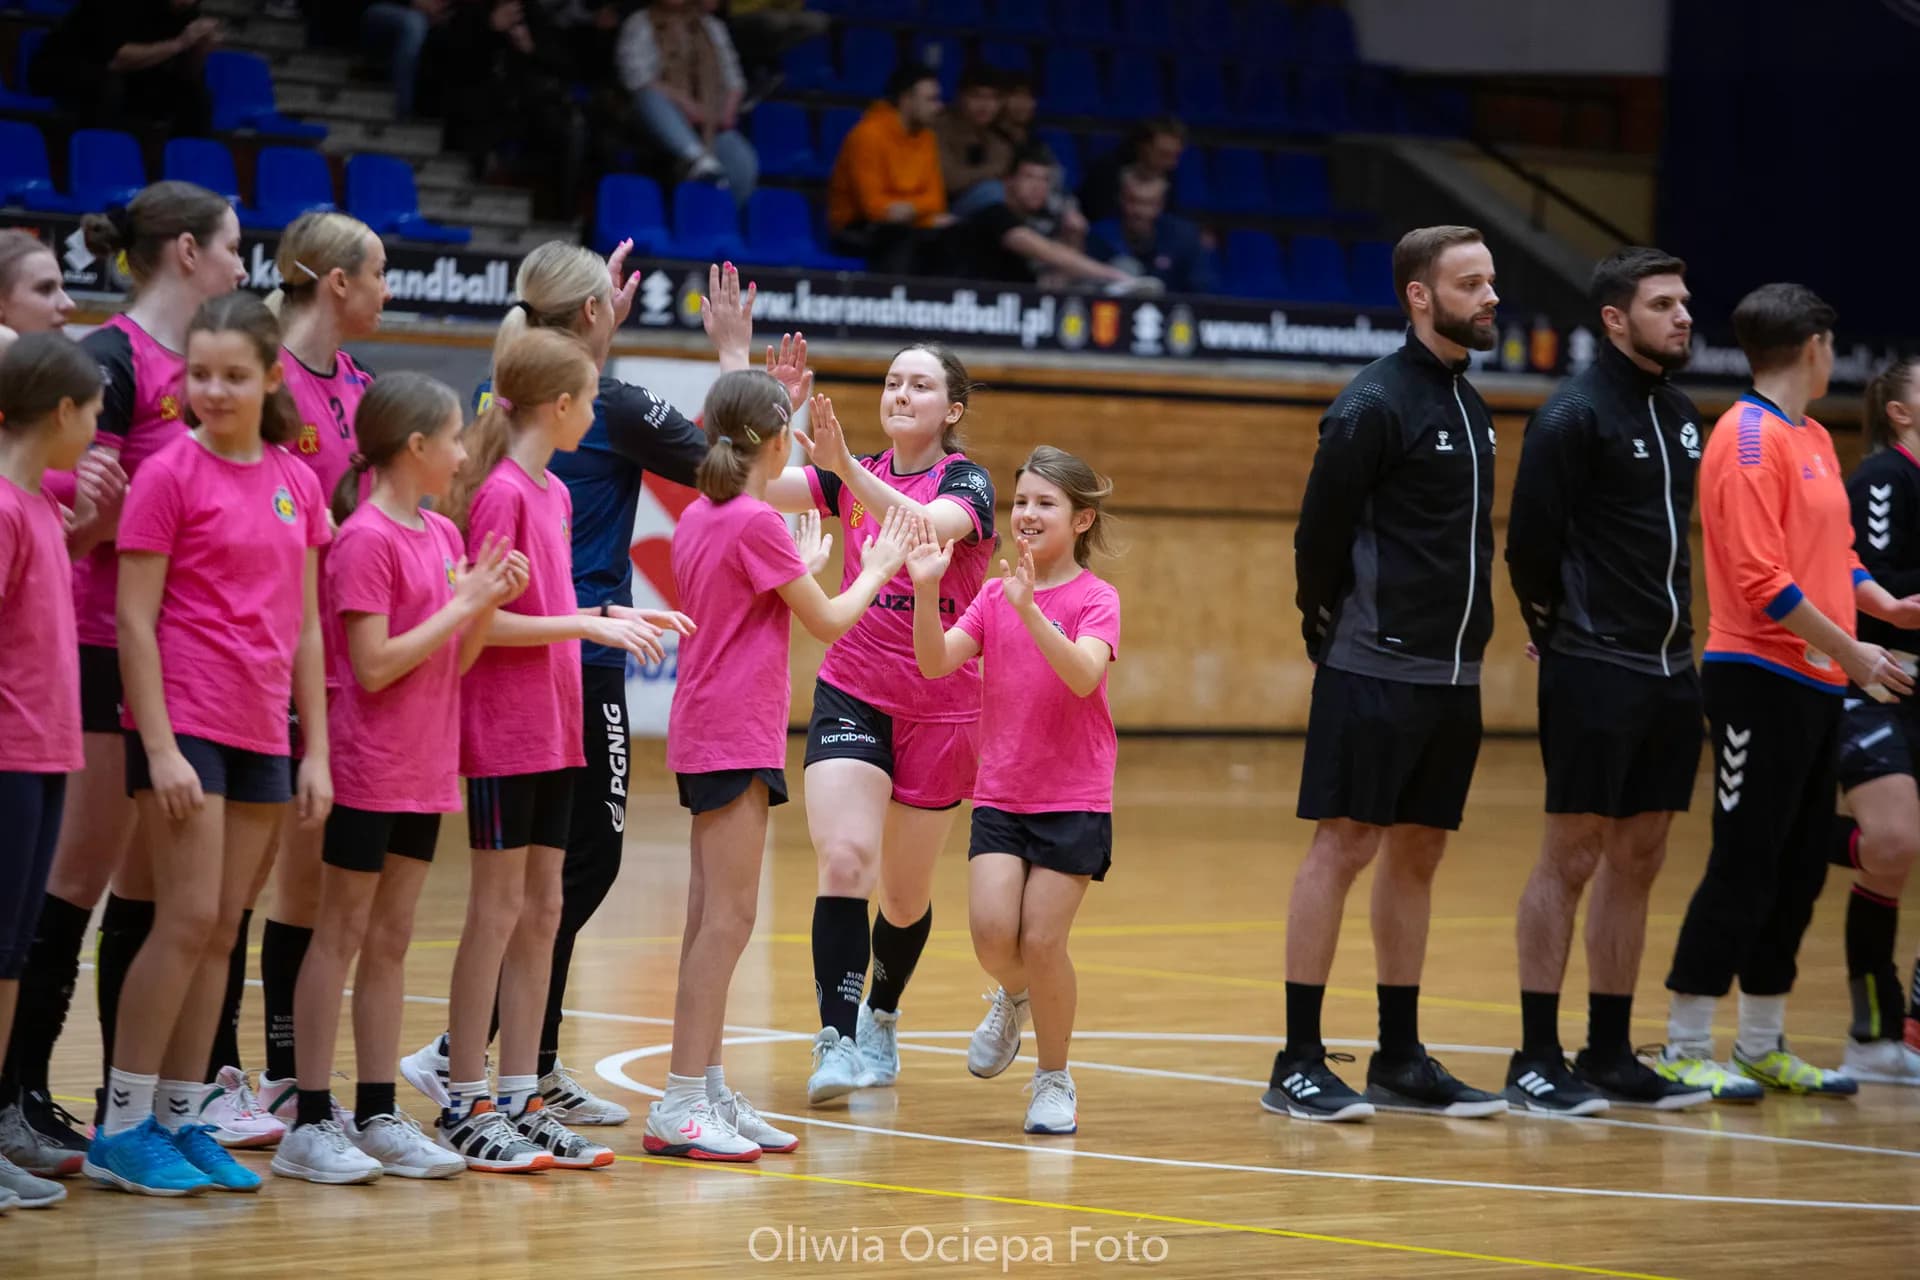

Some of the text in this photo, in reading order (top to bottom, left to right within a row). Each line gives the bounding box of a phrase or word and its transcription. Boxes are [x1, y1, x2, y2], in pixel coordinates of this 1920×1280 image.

[330, 396, 350, 439] 2
[643, 404, 661, 424] Sun
[602, 703, 627, 798] PGNiG
